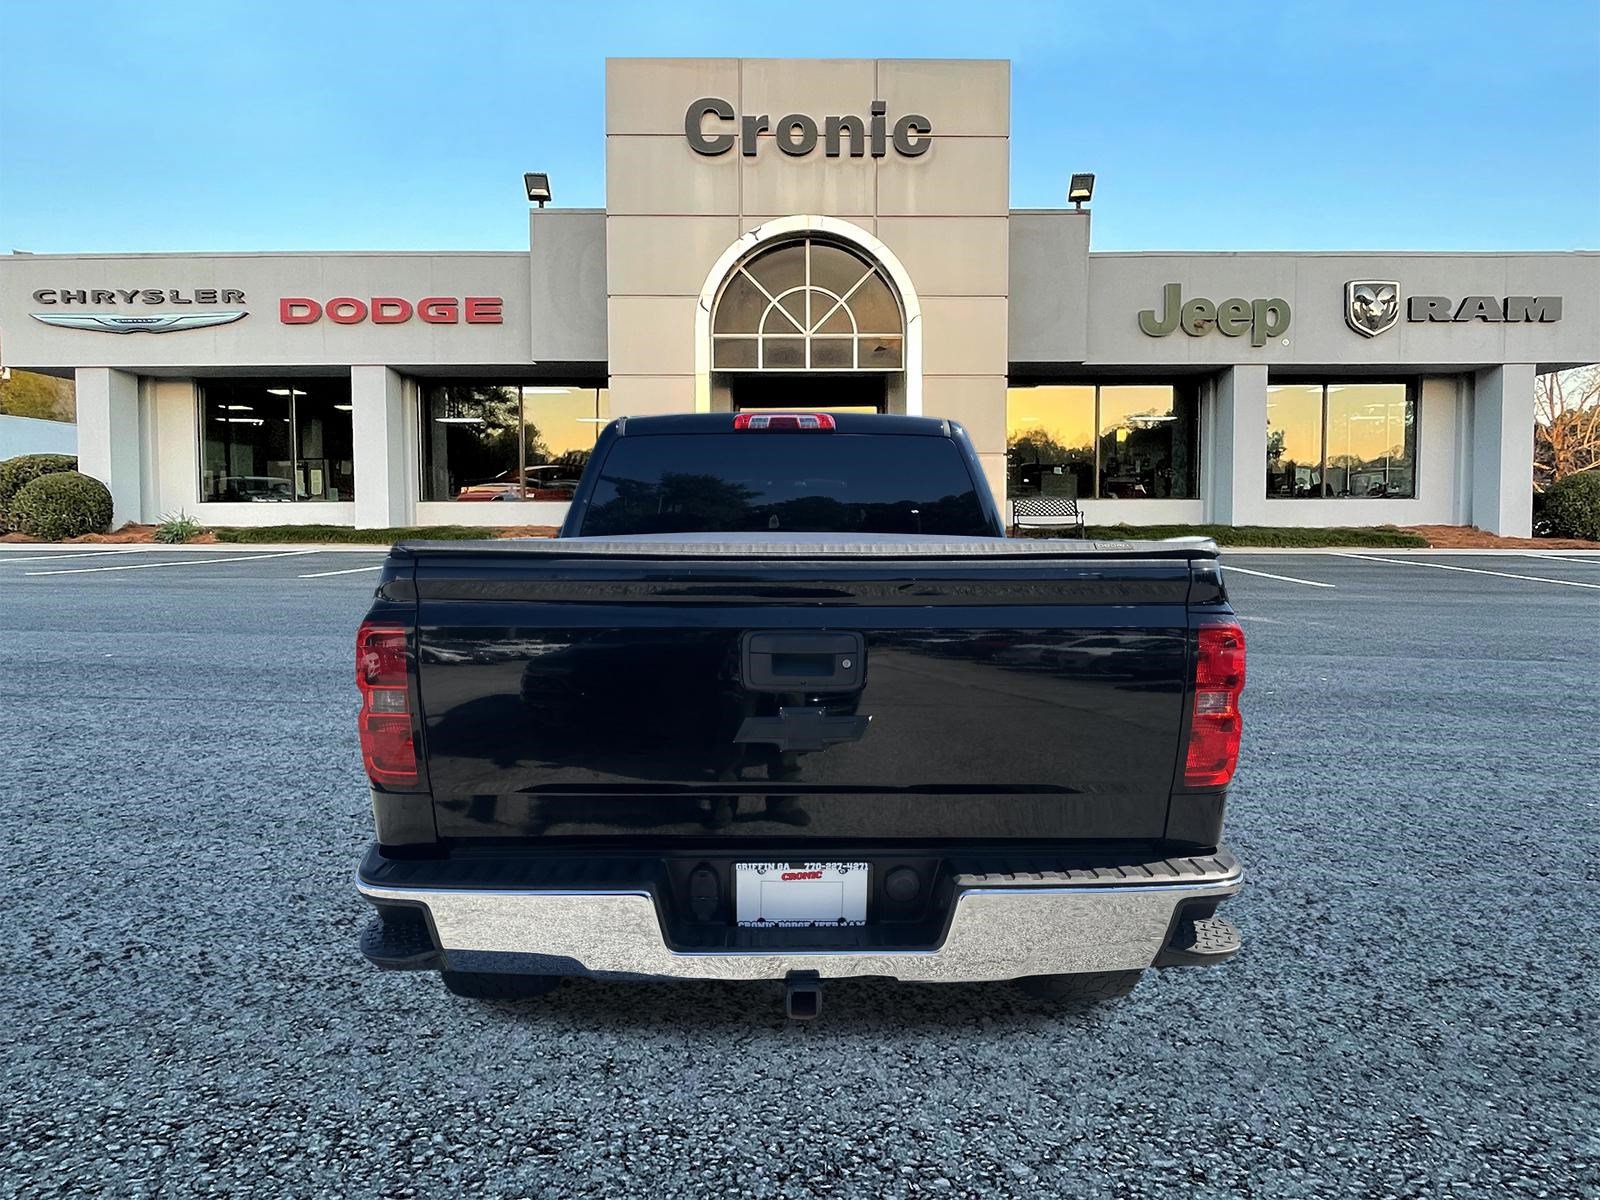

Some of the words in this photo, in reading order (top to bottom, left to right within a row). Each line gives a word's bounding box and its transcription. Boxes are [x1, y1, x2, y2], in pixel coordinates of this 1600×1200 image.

[684, 97, 931, 158] Cronic
[32, 288, 247, 305] CHRYSLER
[1407, 296, 1563, 323] RAM
[279, 297, 504, 325] DODGE
[1138, 283, 1291, 347] Jeep
[781, 871, 822, 881] CRONIC
